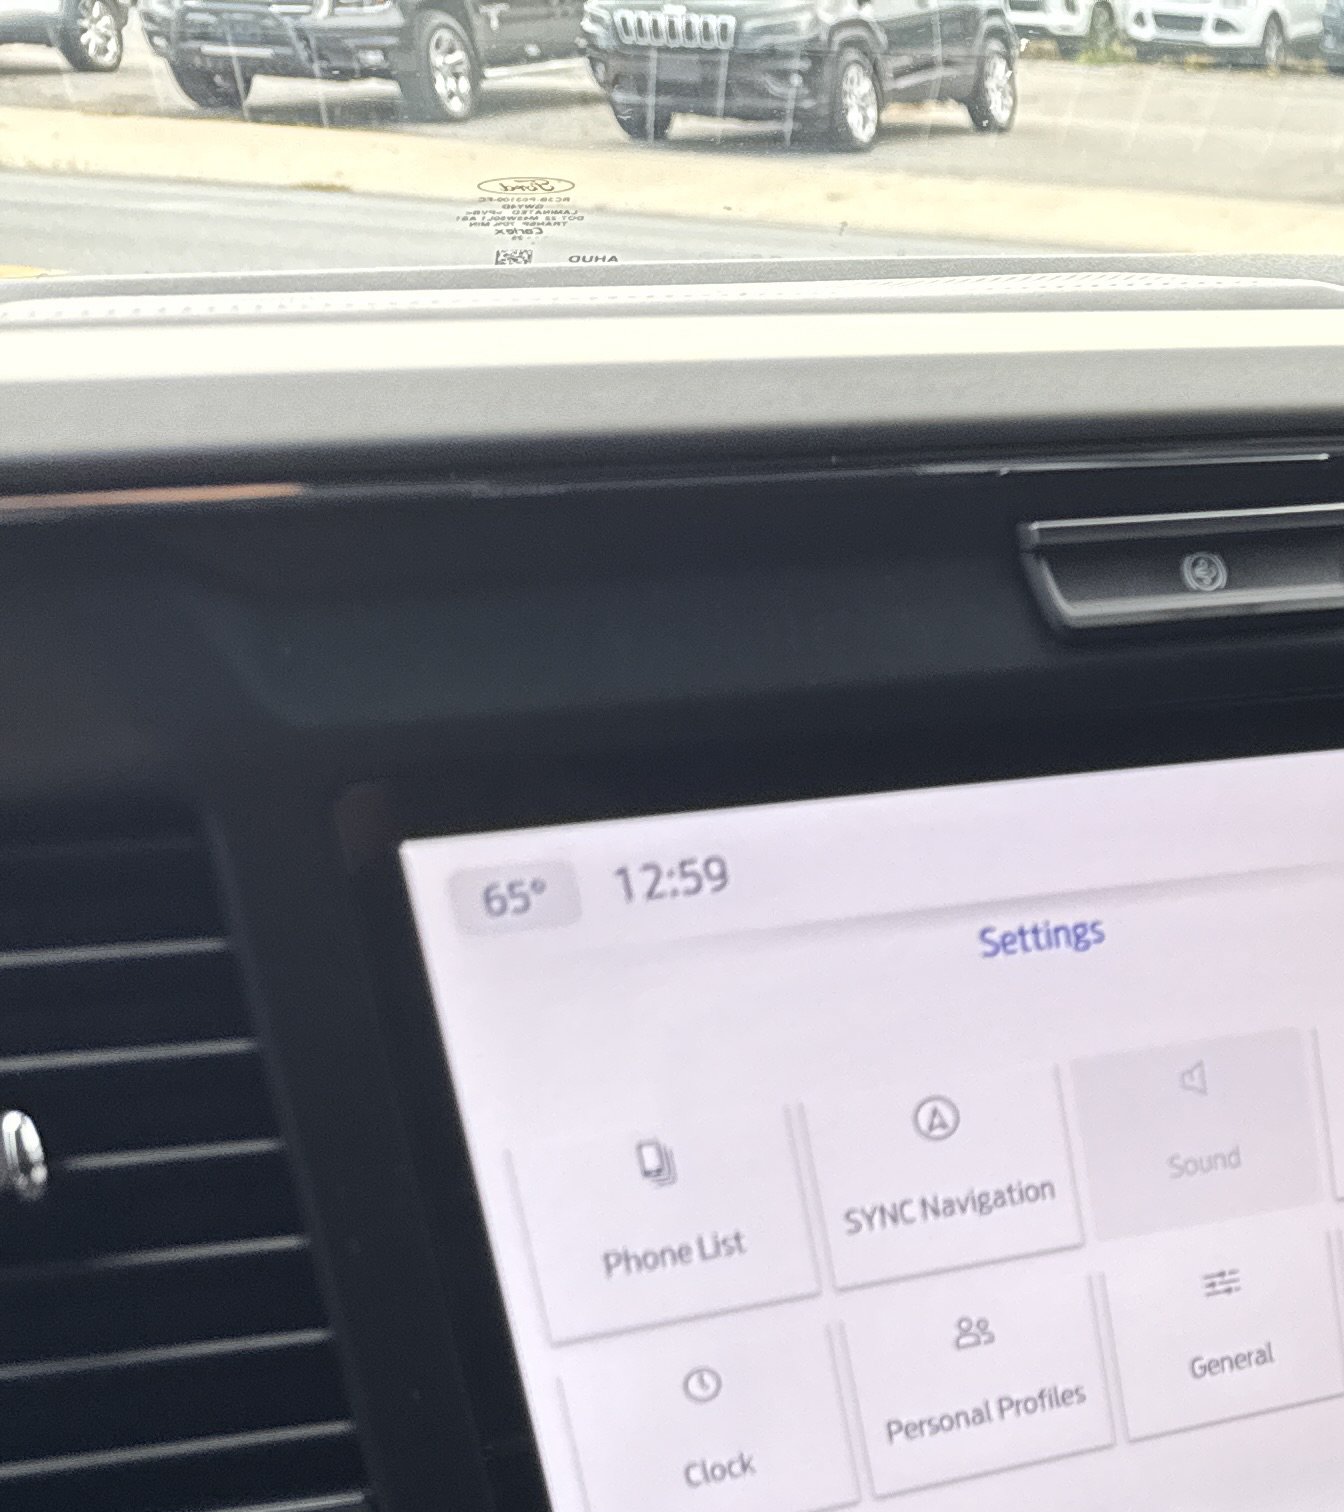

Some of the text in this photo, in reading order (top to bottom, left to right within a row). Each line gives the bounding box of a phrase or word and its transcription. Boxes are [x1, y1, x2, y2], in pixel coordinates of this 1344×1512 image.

[483, 877, 546, 917] 65°
[614, 855, 729, 903] 12:59
[979, 920, 1106, 958] Settings
[1167, 1146, 1242, 1180] Sound
[844, 1179, 1057, 1236] SYNC Navigation
[602, 1229, 746, 1279] Phone List
[1190, 1342, 1275, 1380] General
[885, 1384, 1088, 1446] Personal Profiles
[684, 1451, 756, 1489] Clock
